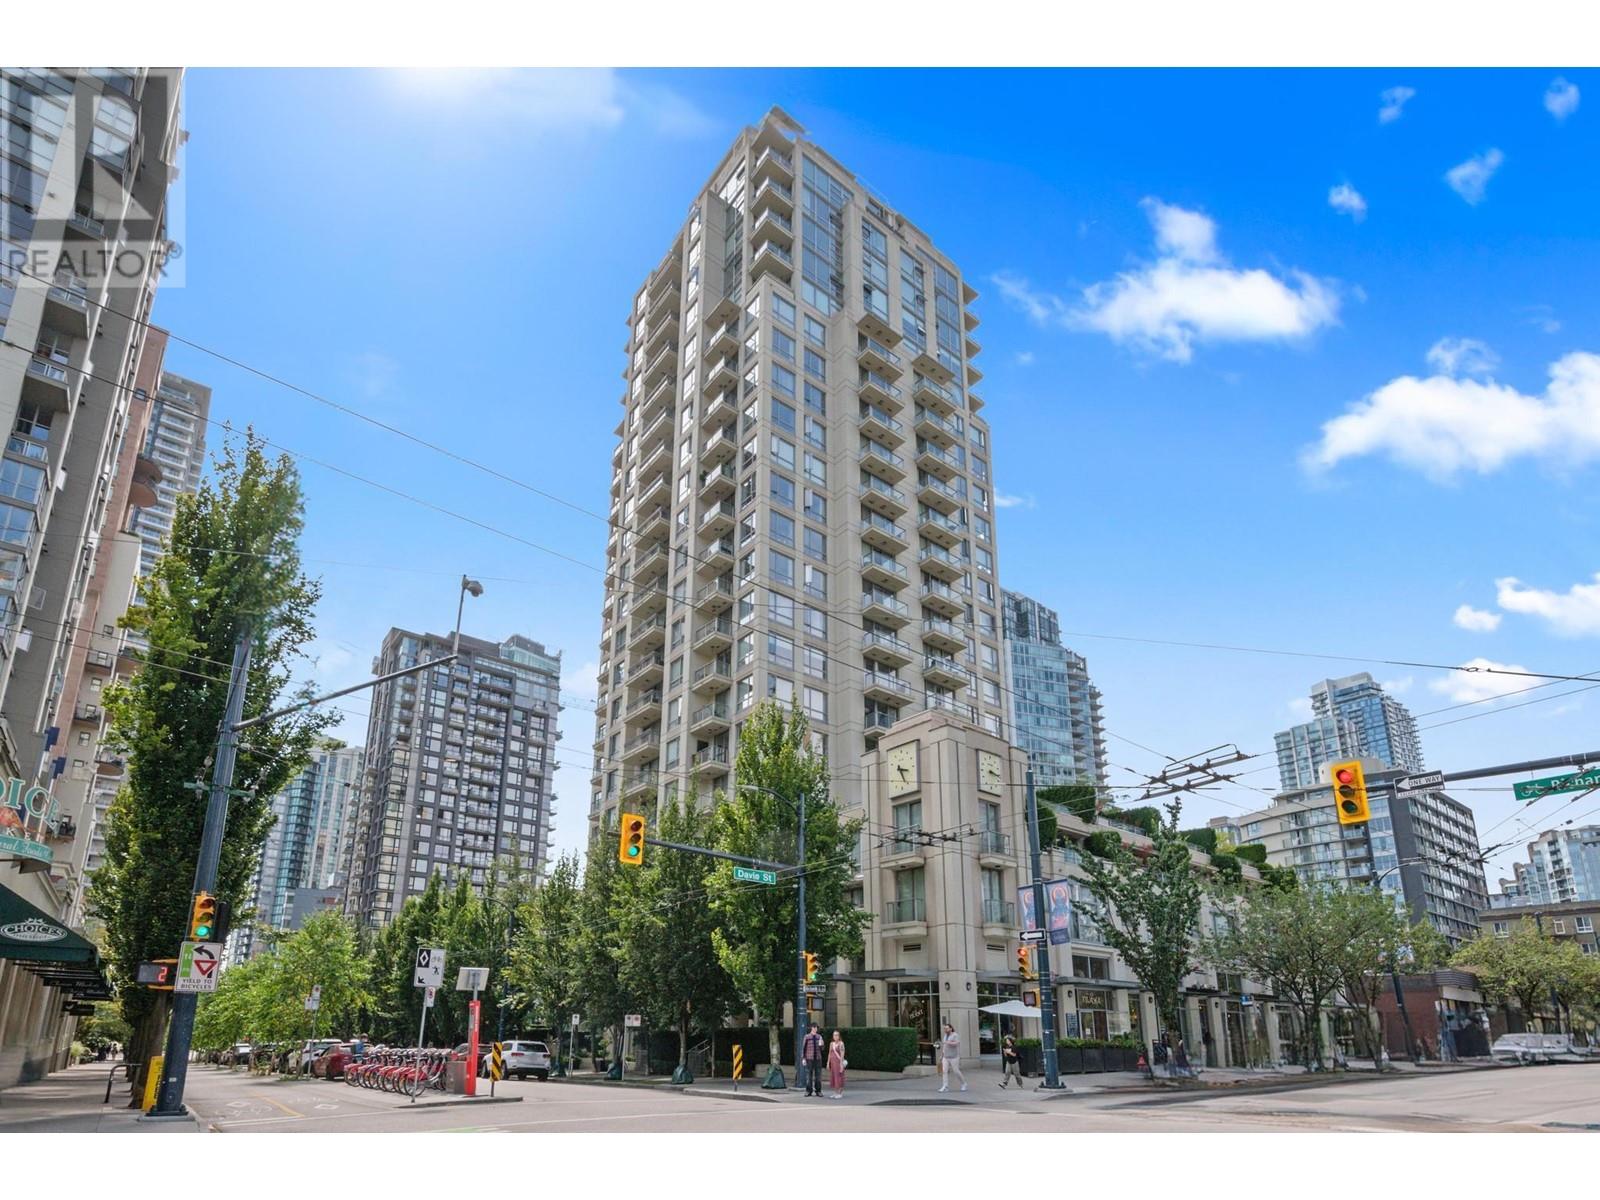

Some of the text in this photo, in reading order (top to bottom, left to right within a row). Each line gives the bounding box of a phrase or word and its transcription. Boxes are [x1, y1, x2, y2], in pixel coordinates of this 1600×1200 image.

[1408, 775, 1440, 787] ONE WAY
[737, 869, 772, 882] Davie St
[4, 924, 66, 937] CHOICES
[157, 965, 169, 982] 2
